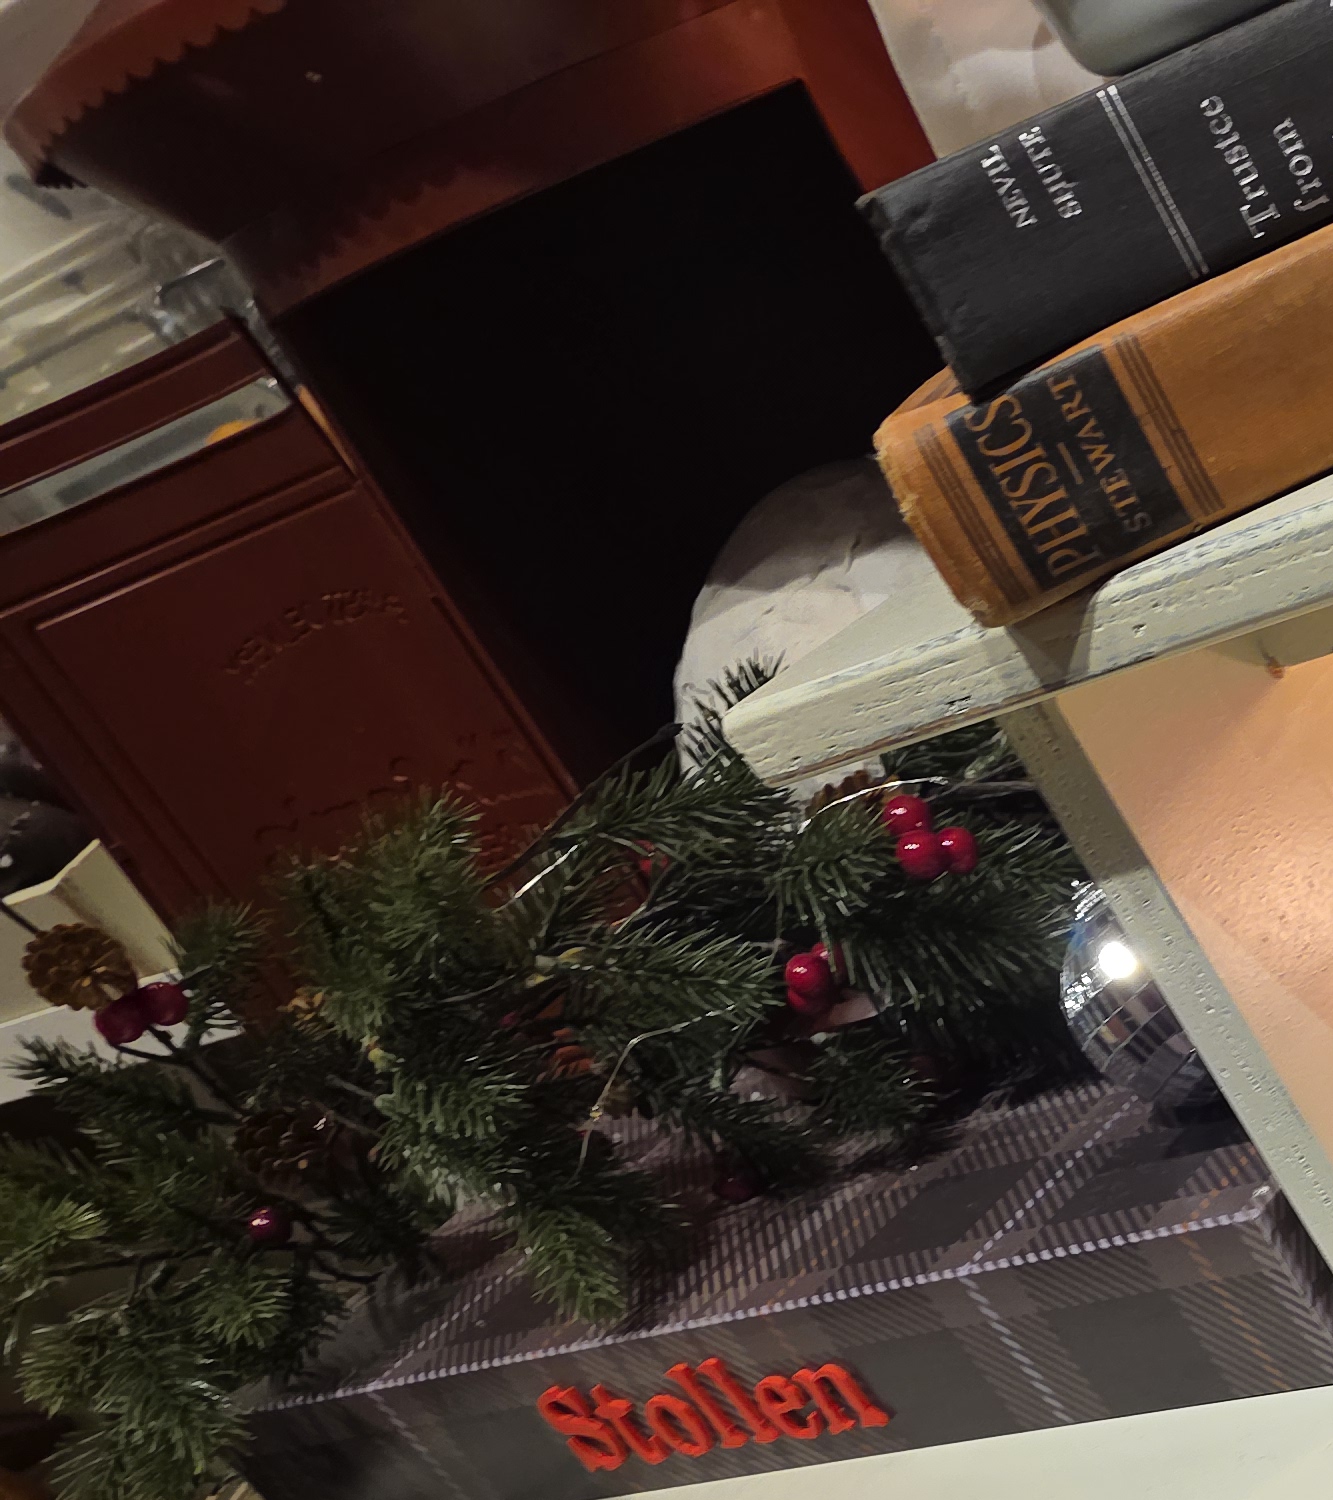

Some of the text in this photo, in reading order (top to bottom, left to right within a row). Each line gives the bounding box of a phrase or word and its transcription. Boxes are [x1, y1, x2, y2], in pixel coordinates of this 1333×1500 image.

[980, 144, 1037, 228] NEVIL
[1018, 126, 1083, 219] SHUTE
[1273, 117, 1330, 212] from
[963, 395, 1100, 577] PHYSICS
[1047, 375, 1151, 533] STEWART
[537, 1356, 891, 1472] Stollen
